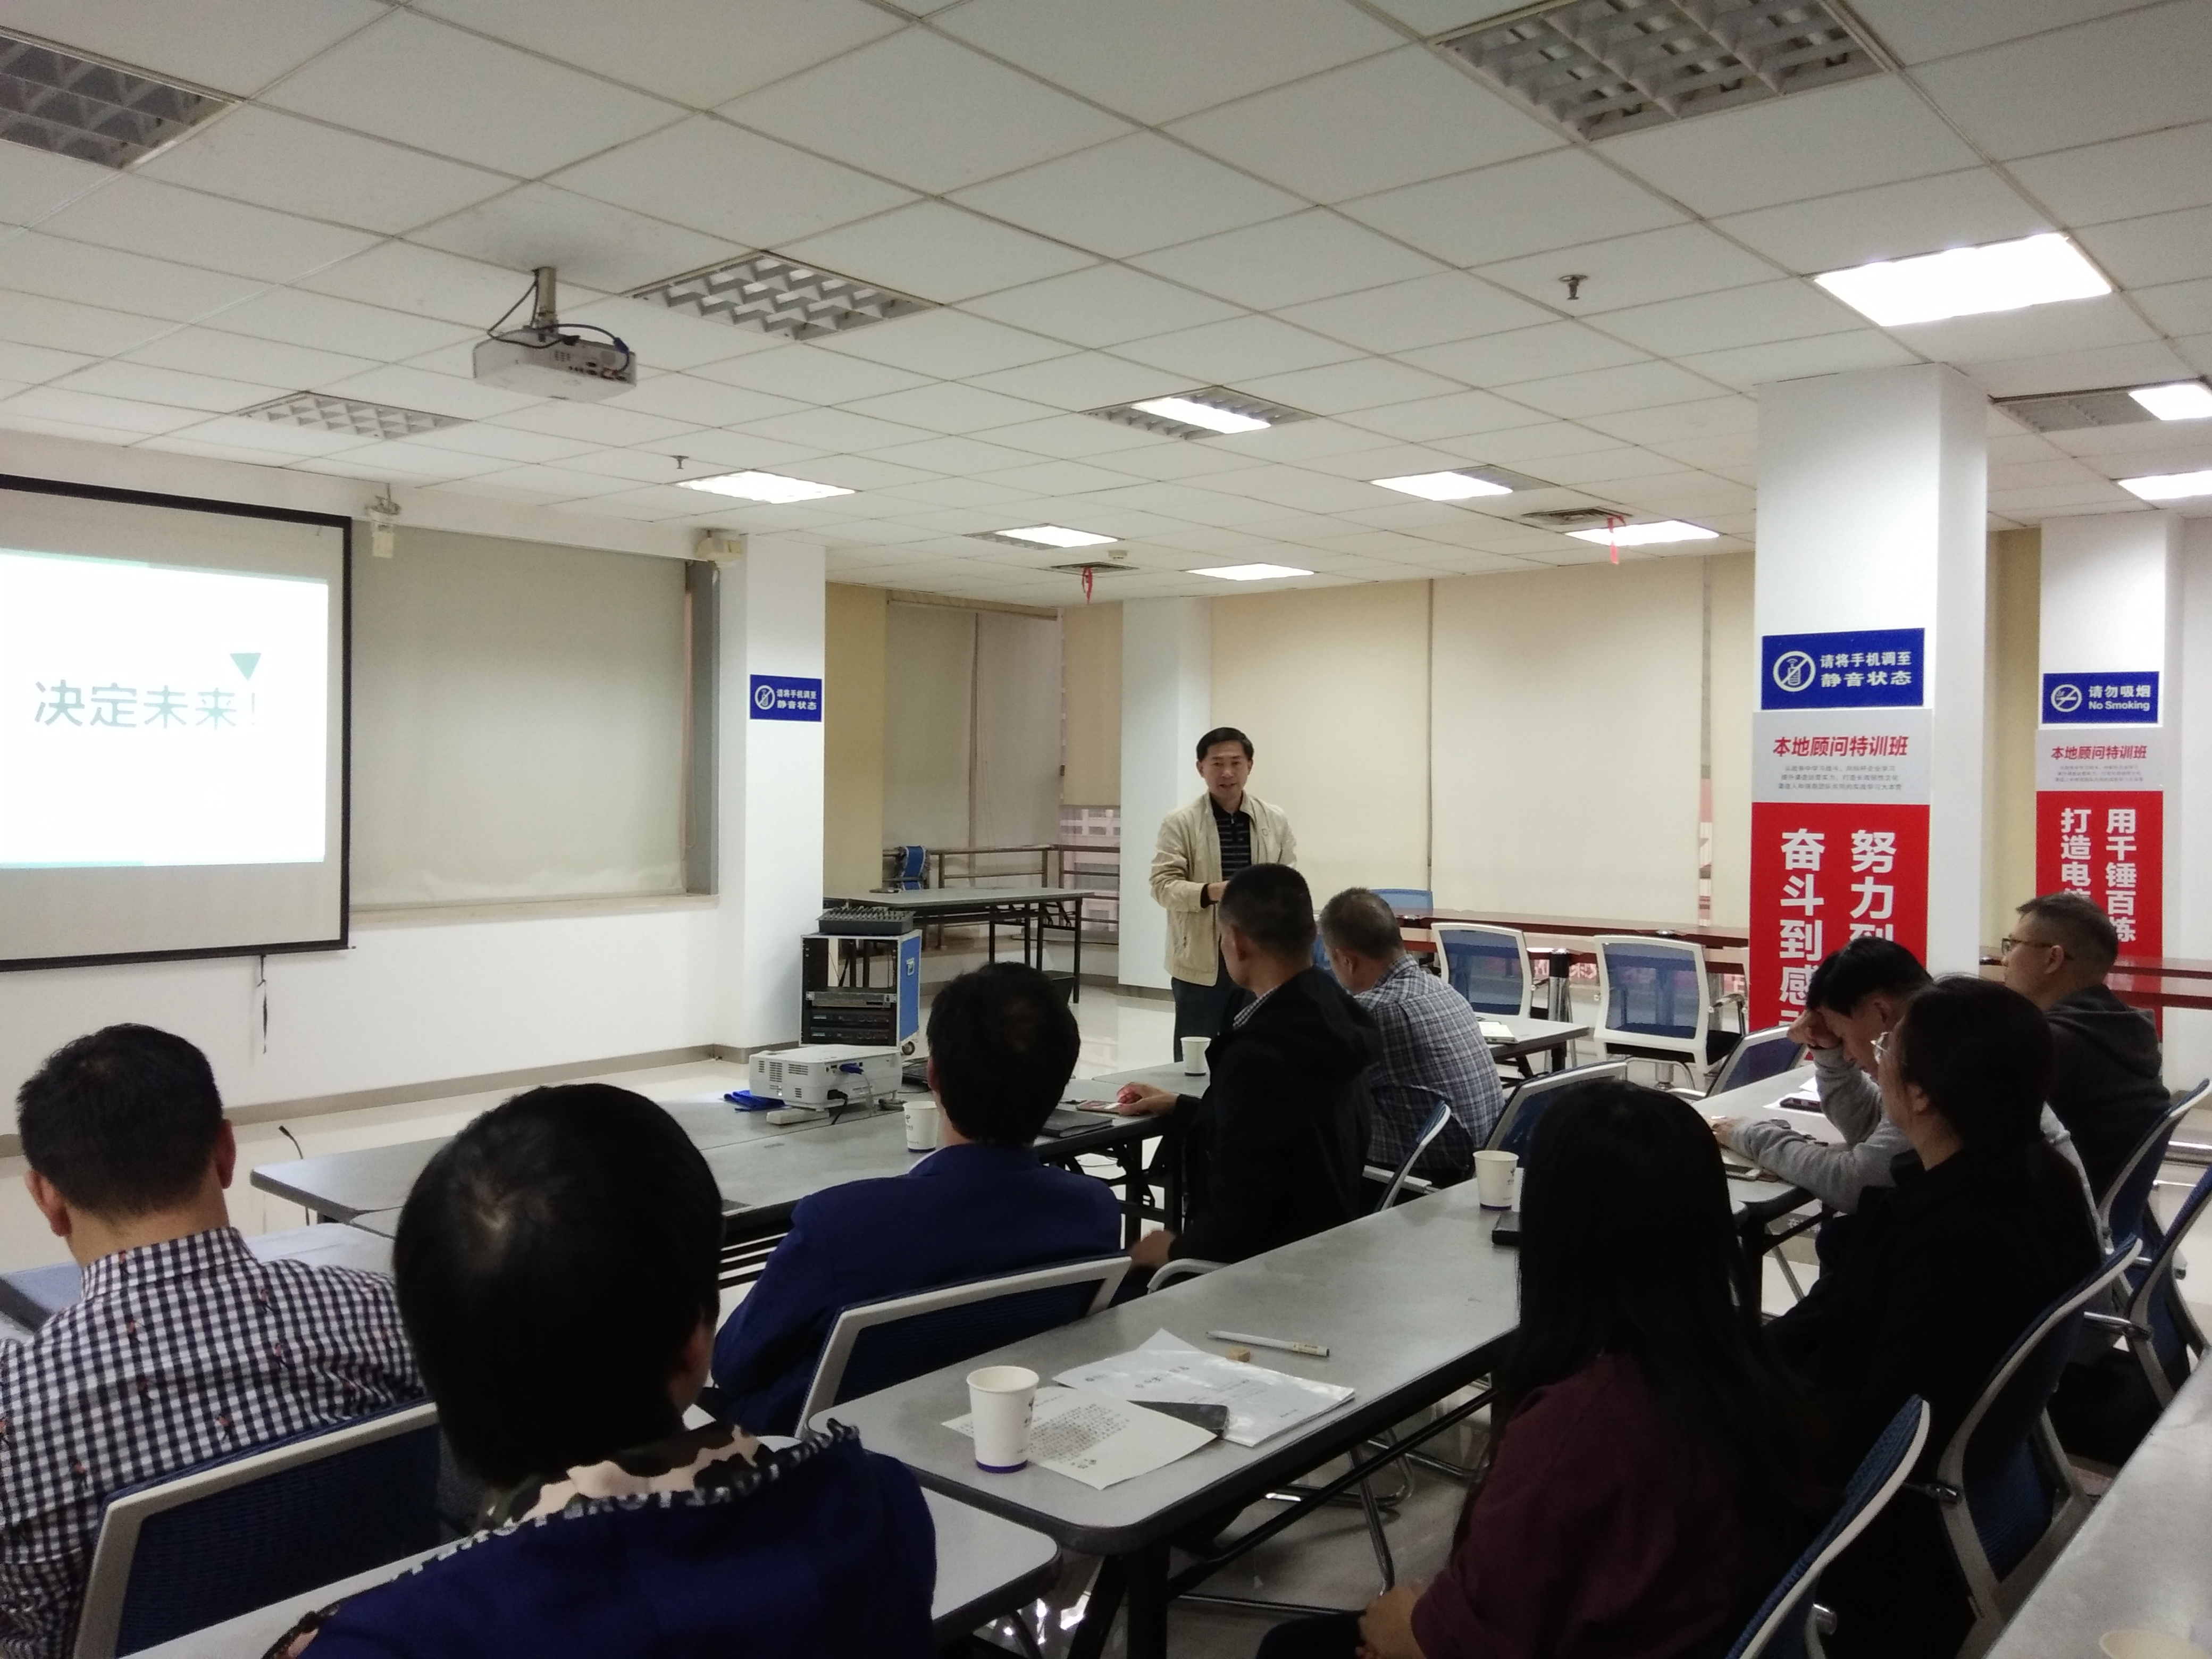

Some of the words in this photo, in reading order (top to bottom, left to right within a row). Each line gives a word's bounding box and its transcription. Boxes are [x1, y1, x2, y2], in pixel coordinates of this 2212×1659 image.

[1820, 651, 1912, 668] 请将手机调至
[1821, 671, 1912, 687] 静音状态
[2089, 685, 2151, 698] 请勿吸烟
[777, 700, 817, 710] 静音状态
[2105, 701, 2150, 711] Smoking
[1773, 735, 1909, 757] 本地顾问特训班
[2051, 745, 2148, 760] 本地顾问特训班
[2060, 807, 2092, 899] 打造电
